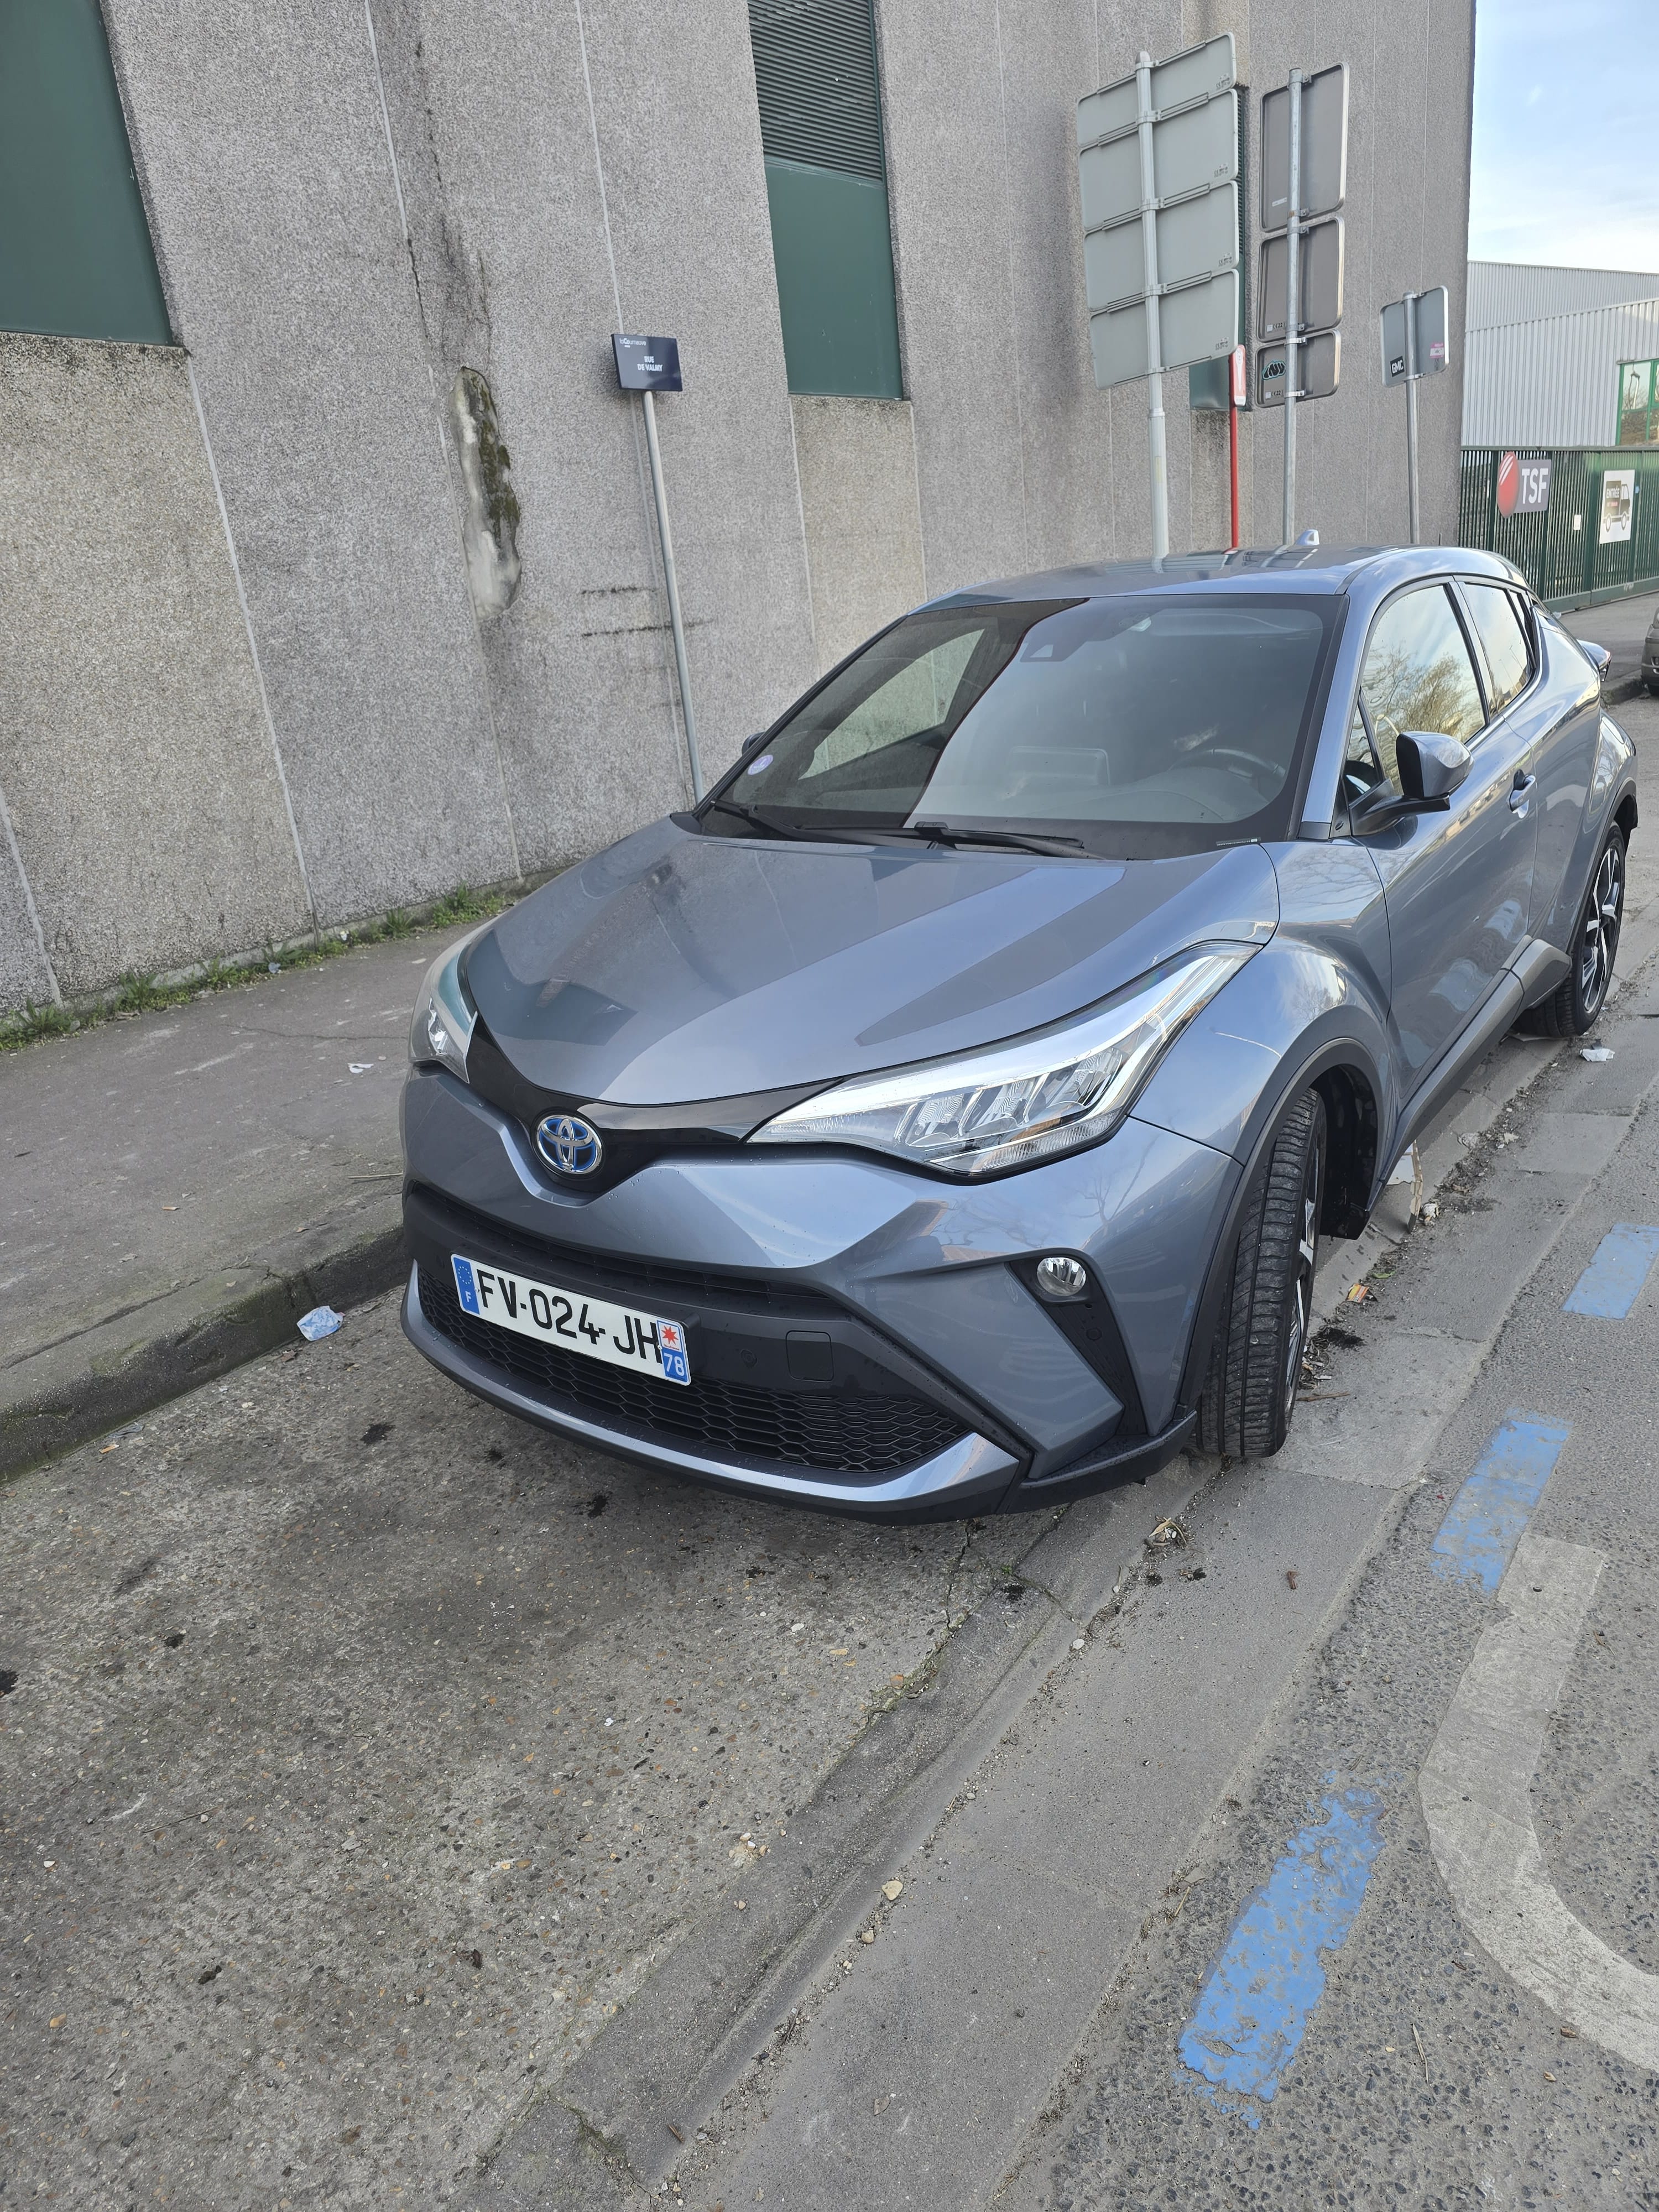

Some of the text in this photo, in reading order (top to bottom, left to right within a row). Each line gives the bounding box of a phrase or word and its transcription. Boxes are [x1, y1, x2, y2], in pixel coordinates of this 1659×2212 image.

[1391, 359, 1404, 374] GMC
[1521, 467, 1549, 505] TSF
[465, 1290, 472, 1303] F
[476, 1269, 663, 1364] FV-024-JH
[664, 1353, 685, 1376] 78
